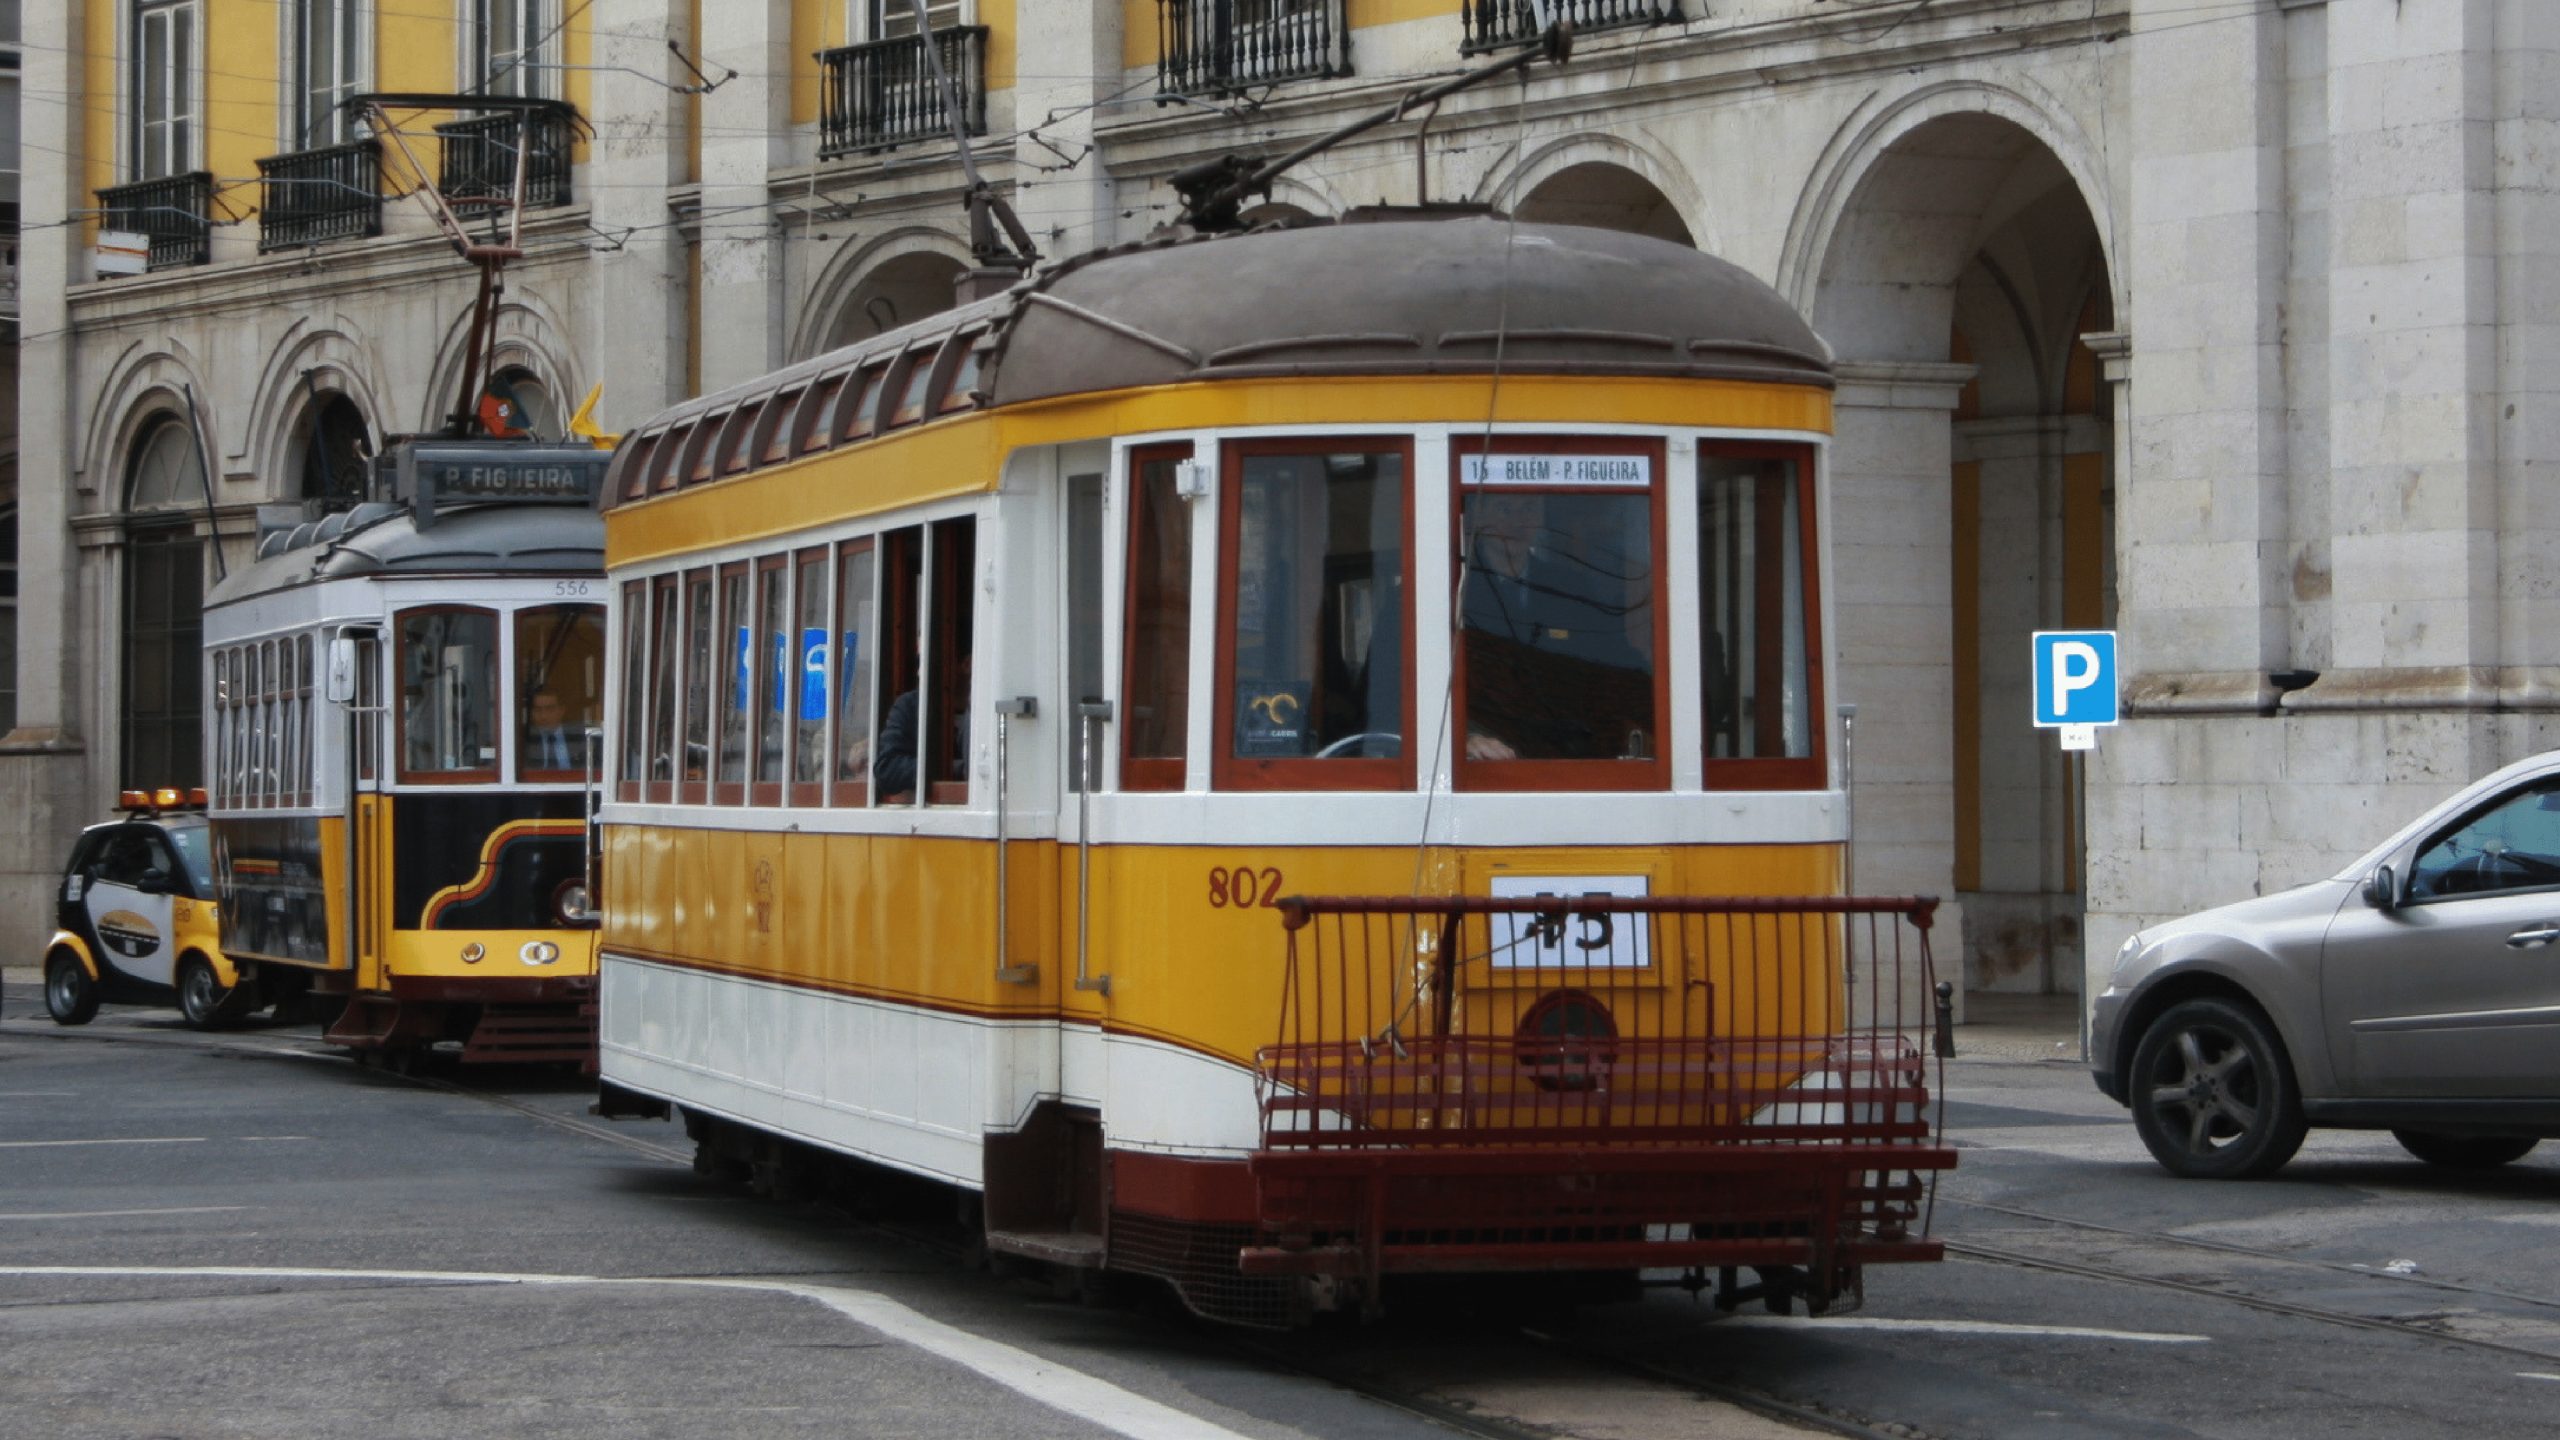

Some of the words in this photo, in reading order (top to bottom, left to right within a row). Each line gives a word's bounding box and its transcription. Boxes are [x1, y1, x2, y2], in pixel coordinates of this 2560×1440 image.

[1506, 456, 1550, 480] BELÉM
[1578, 461, 1640, 481] FIGUEIRA
[555, 580, 589, 596] 556
[2052, 641, 2099, 717] P
[1208, 866, 1283, 909] 802
